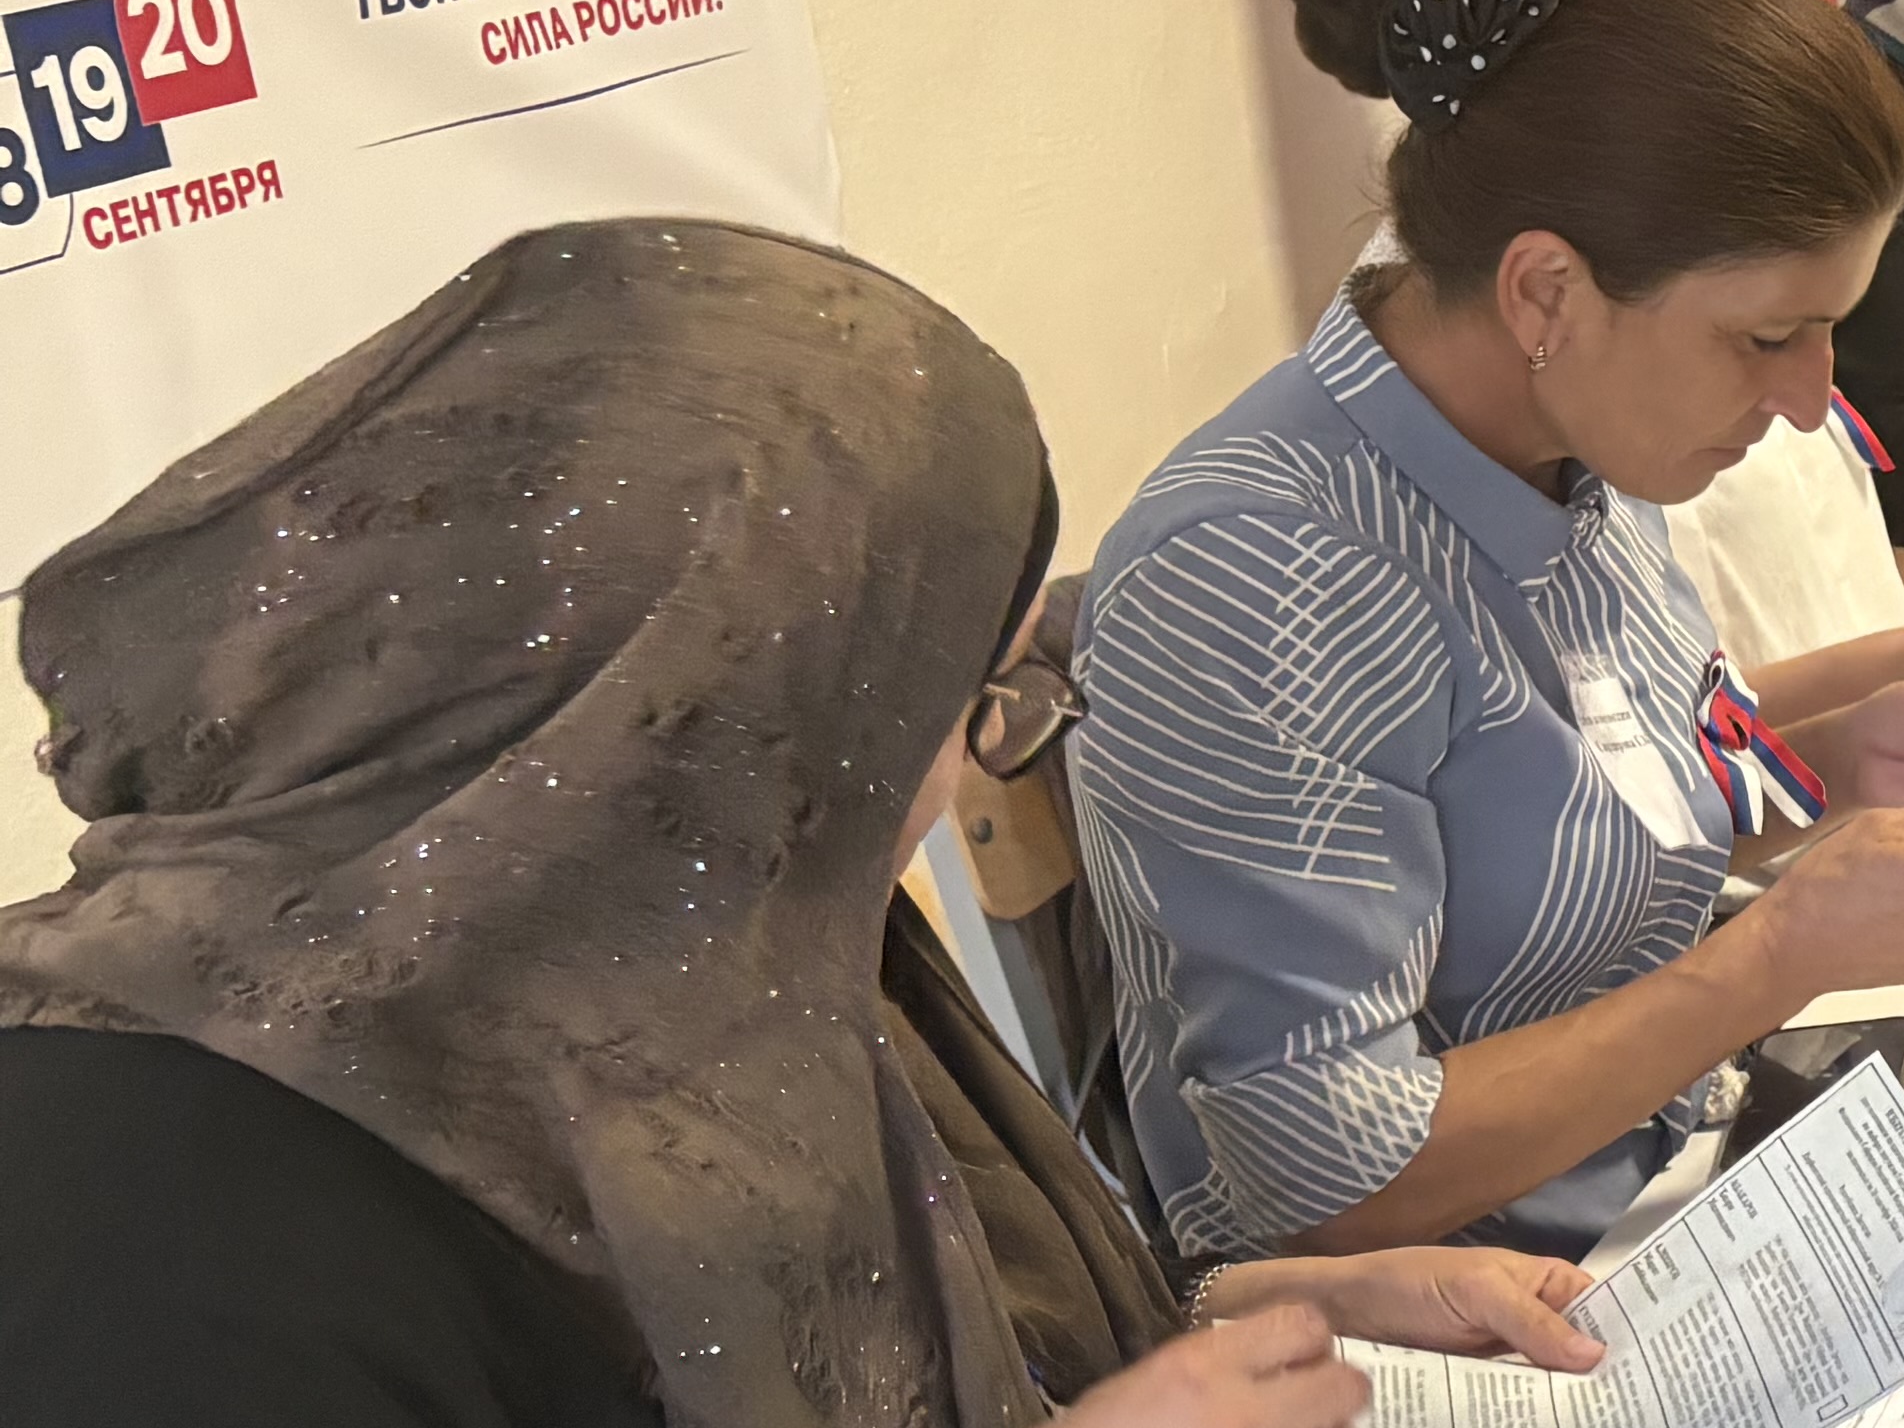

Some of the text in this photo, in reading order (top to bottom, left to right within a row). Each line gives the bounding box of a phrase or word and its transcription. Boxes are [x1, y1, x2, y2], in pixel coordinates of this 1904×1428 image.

[480, 14, 577, 66] СИЛА
[30, 45, 129, 152] 19
[81, 159, 285, 251] СЕНТЯБРЯ
